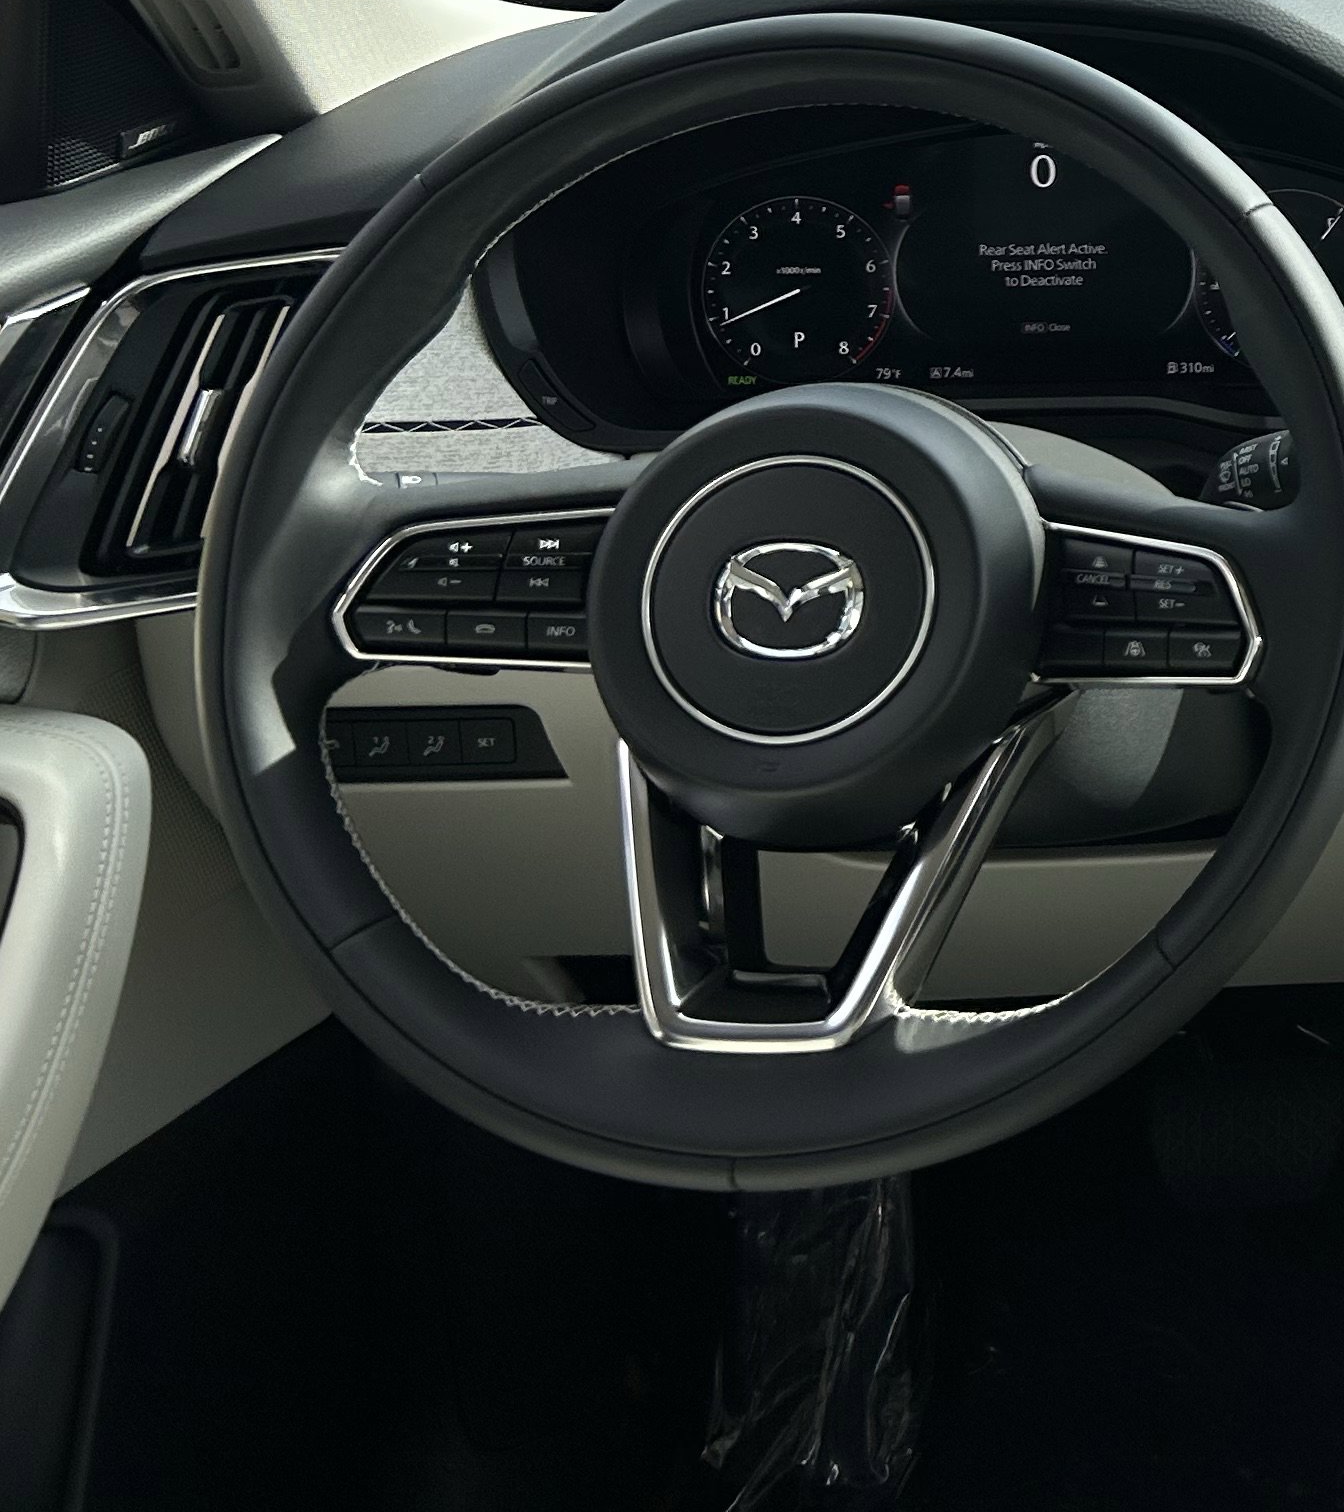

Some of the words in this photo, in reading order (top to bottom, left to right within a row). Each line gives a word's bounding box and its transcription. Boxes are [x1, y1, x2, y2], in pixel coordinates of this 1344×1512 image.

[1030, 154, 1057, 188] 0
[791, 211, 801, 224] 4
[750, 226, 759, 239] 3
[836, 225, 846, 238] 5
[979, 244, 1007, 256] Rear
[1009, 243, 1035, 256] Seat
[1037, 243, 1066, 255] Alert
[1068, 243, 1108, 255] Active.
[721, 262, 731, 275] 2
[866, 259, 876, 272] 6
[991, 259, 1022, 271] Press
[1024, 259, 1055, 271] INFO
[1057, 258, 1097, 270] Switch
[1005, 276, 1018, 286] to
[1021, 274, 1084, 286] Deactivate
[722, 307, 730, 320] 1
[867, 305, 878, 318] 7
[1024, 324, 1044, 332] INFO
[1049, 324, 1071, 332] Close
[751, 342, 761, 356] 0
[794, 332, 805, 348] P
[839, 341, 849, 355] 8
[728, 376, 757, 385] READY
[1239, 463, 1259, 475] AUTO
[523, 555, 566, 566] SOURCE
[1076, 574, 1111, 585] CANCEL
[1153, 580, 1172, 590] RES
[546, 625, 576, 637] INFO
[477, 738, 497, 748] SET
